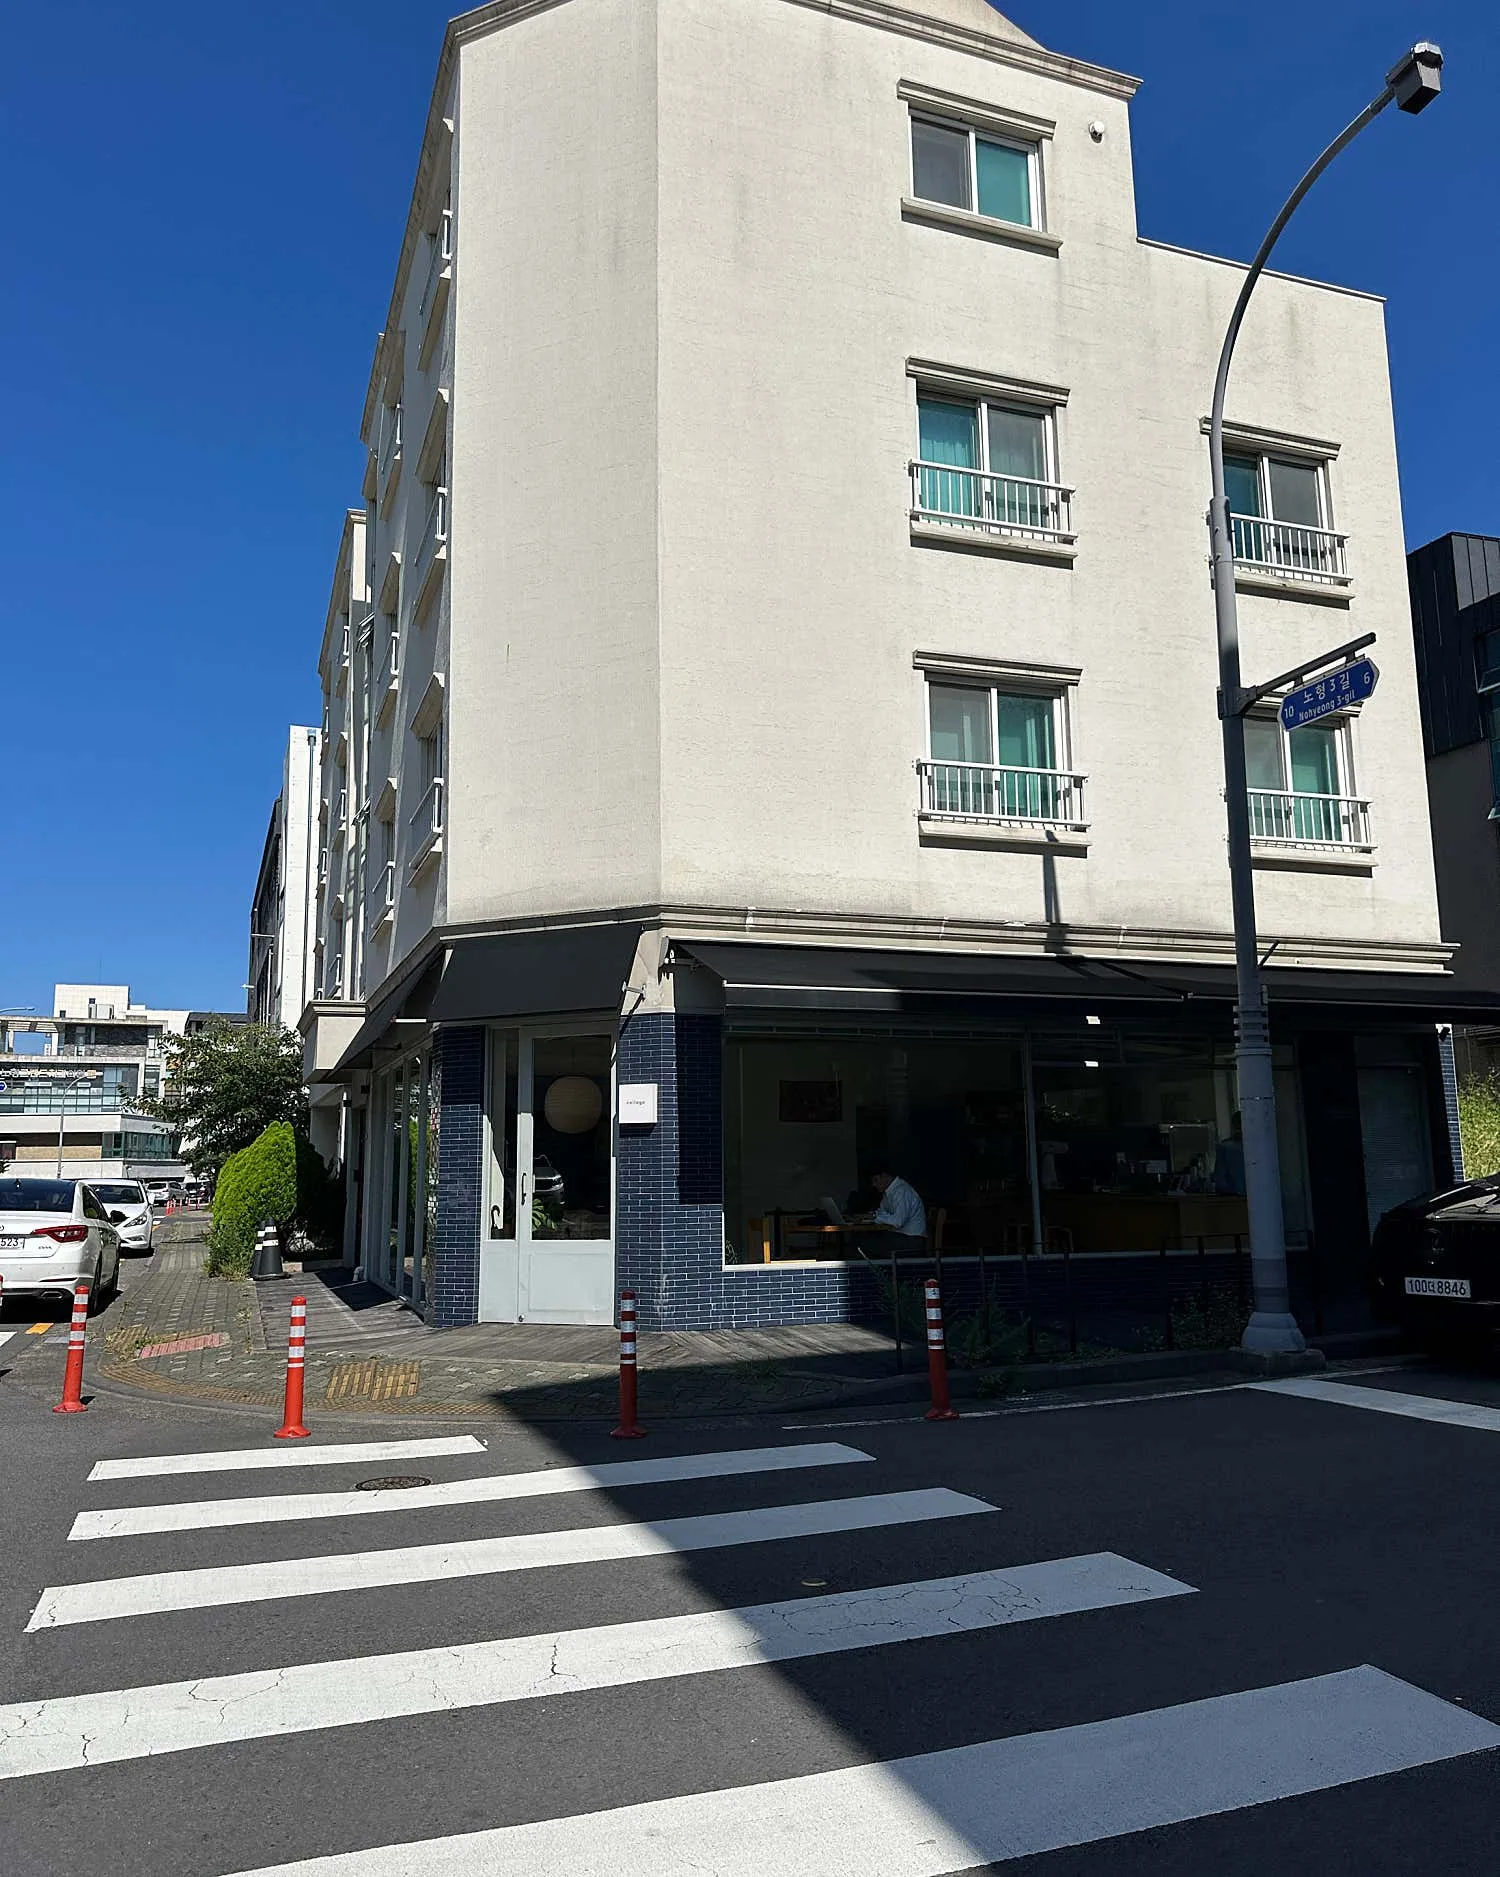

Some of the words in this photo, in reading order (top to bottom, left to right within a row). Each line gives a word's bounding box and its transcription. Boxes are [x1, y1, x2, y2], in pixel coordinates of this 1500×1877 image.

[1363, 672, 1370, 684] 6
[1304, 672, 1350, 703] 노형3길
[1284, 705, 1294, 719] 10
[1299, 700, 1335, 720] Nohyeong
[1337, 690, 1355, 706] 3-gil
[1437, 1280, 1466, 1296] 8846
